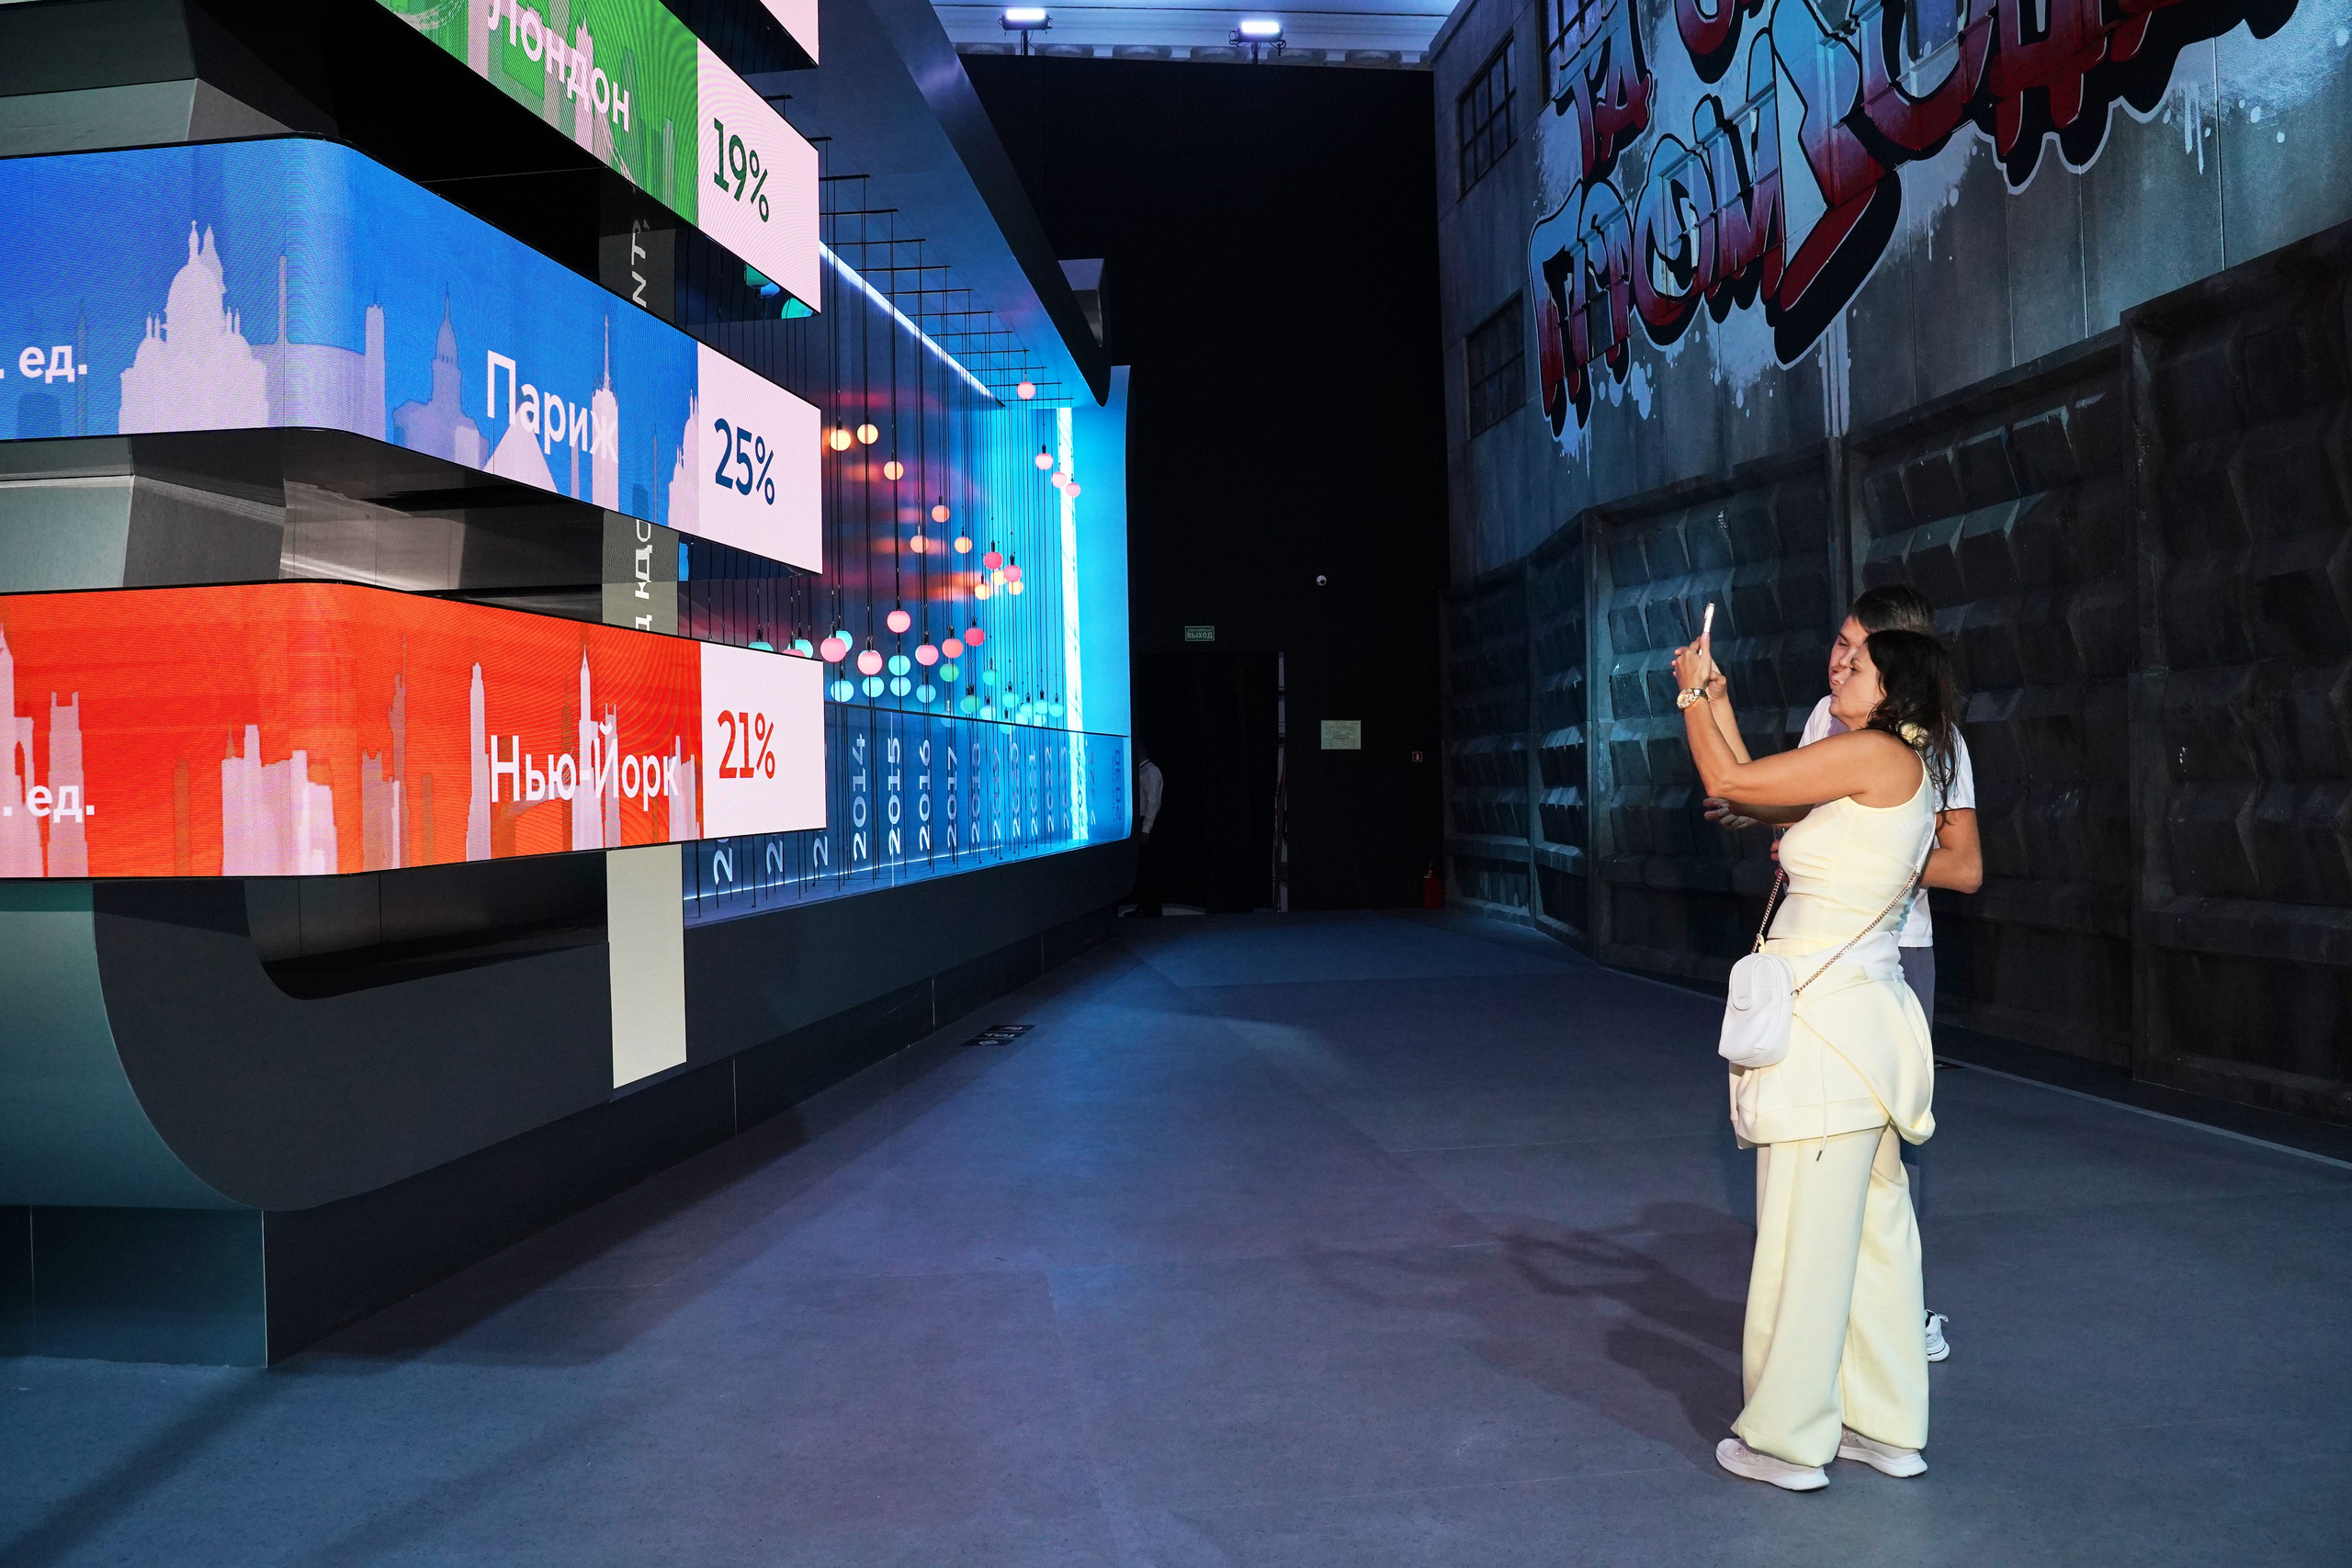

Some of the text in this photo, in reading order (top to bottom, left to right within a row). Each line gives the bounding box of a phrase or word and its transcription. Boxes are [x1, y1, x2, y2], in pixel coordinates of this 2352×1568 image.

[488, 0, 630, 133] Лондон
[713, 117, 769, 223] 19%
[19, 345, 88, 384] ед.
[487, 349, 618, 464] Париж
[714, 418, 775, 506] 25%
[1186, 631, 1213, 639] ВЫХОД
[490, 720, 680, 812] Нью-Йорк
[717, 709, 775, 780] 21%
[919, 739, 931, 852] 2016
[28, 784, 95, 823] ед.
[853, 733, 866, 862] 2014
[888, 738, 900, 856] 2015
[947, 746, 957, 849] 2017
